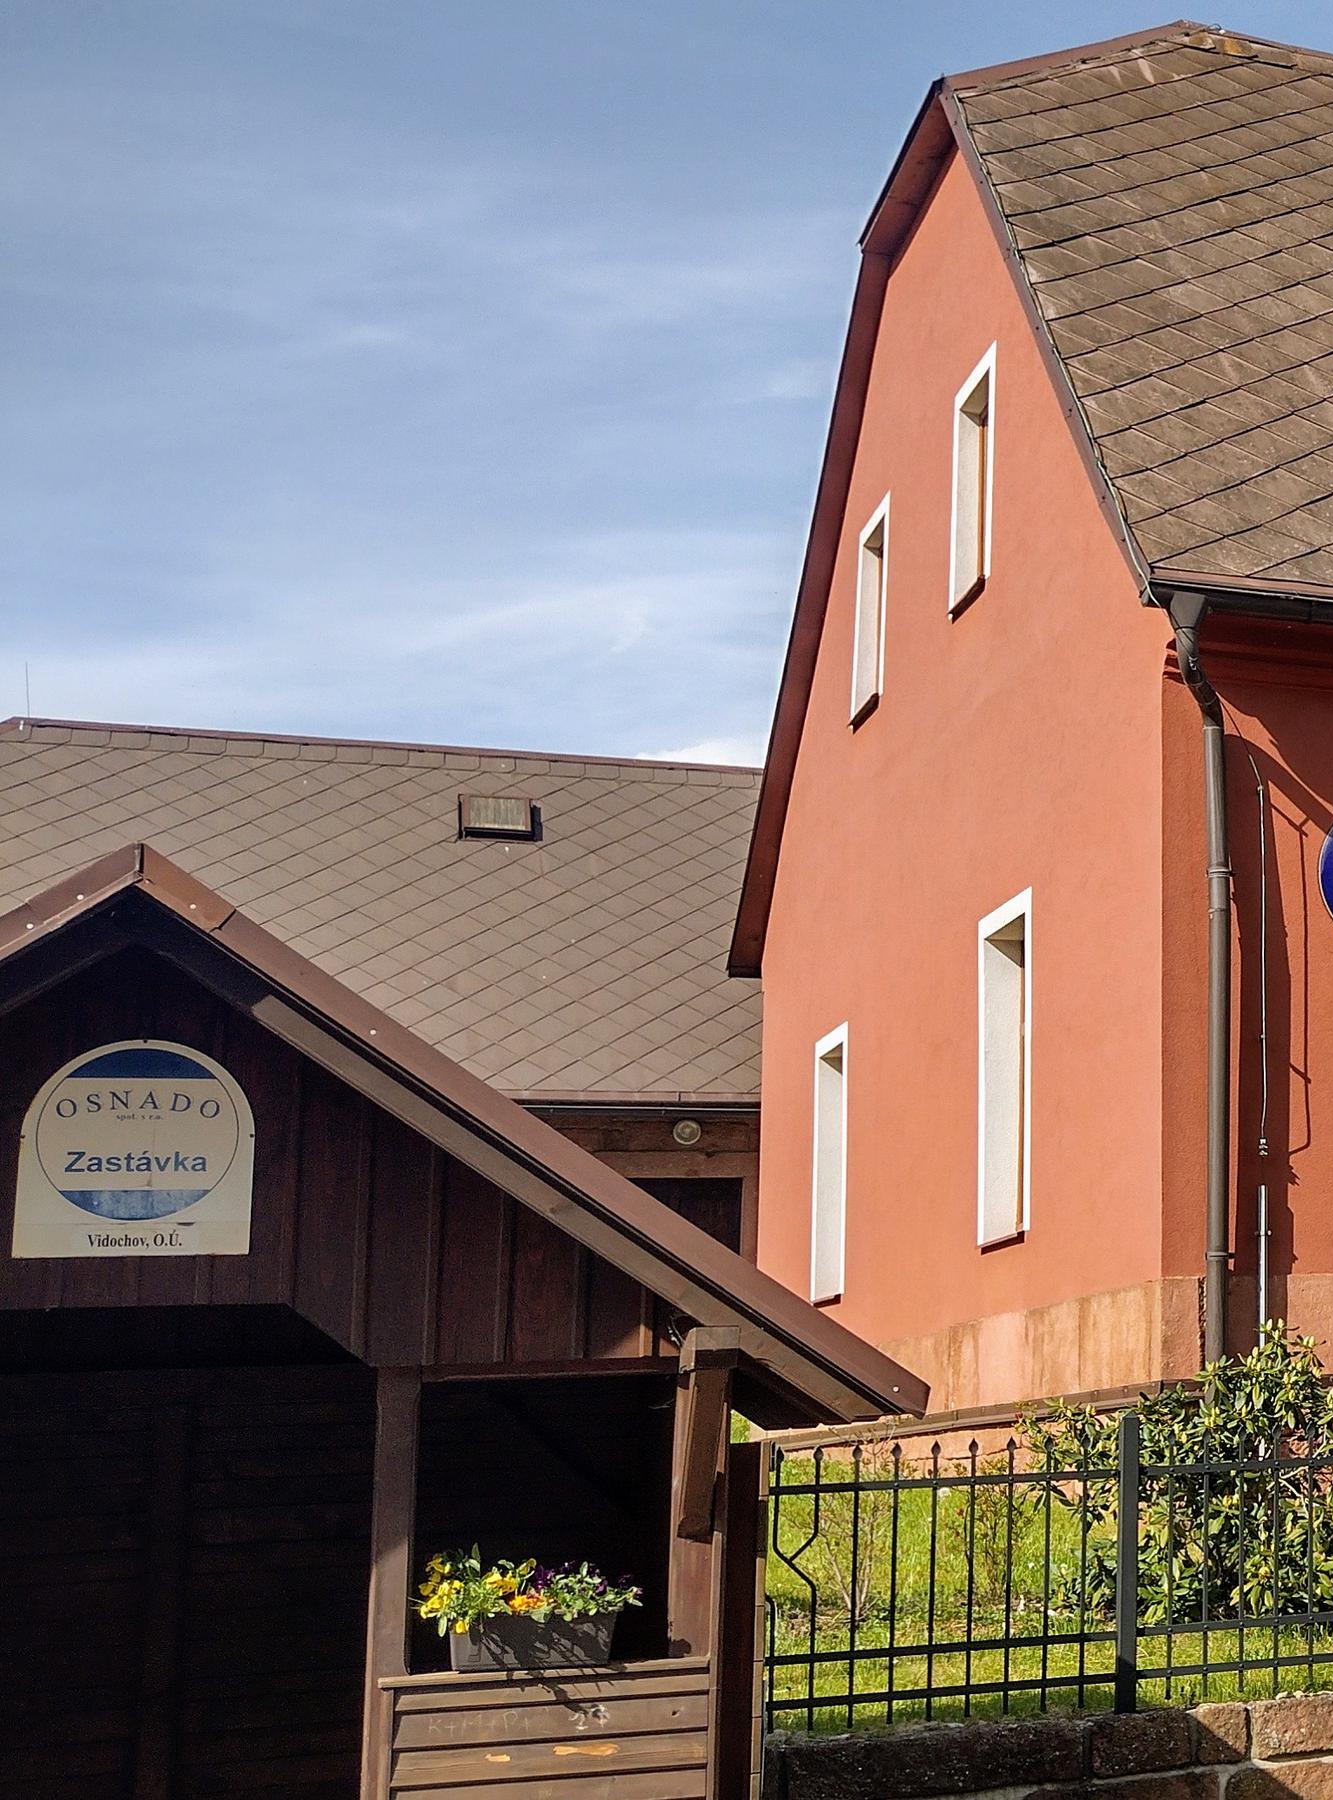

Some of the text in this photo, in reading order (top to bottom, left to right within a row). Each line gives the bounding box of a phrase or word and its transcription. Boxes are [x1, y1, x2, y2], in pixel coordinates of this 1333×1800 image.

[56, 1090, 221, 1118] OSNADO
[64, 1150, 208, 1173] Zastávka
[87, 1229, 182, 1250] Vidochov, O.Ú.
